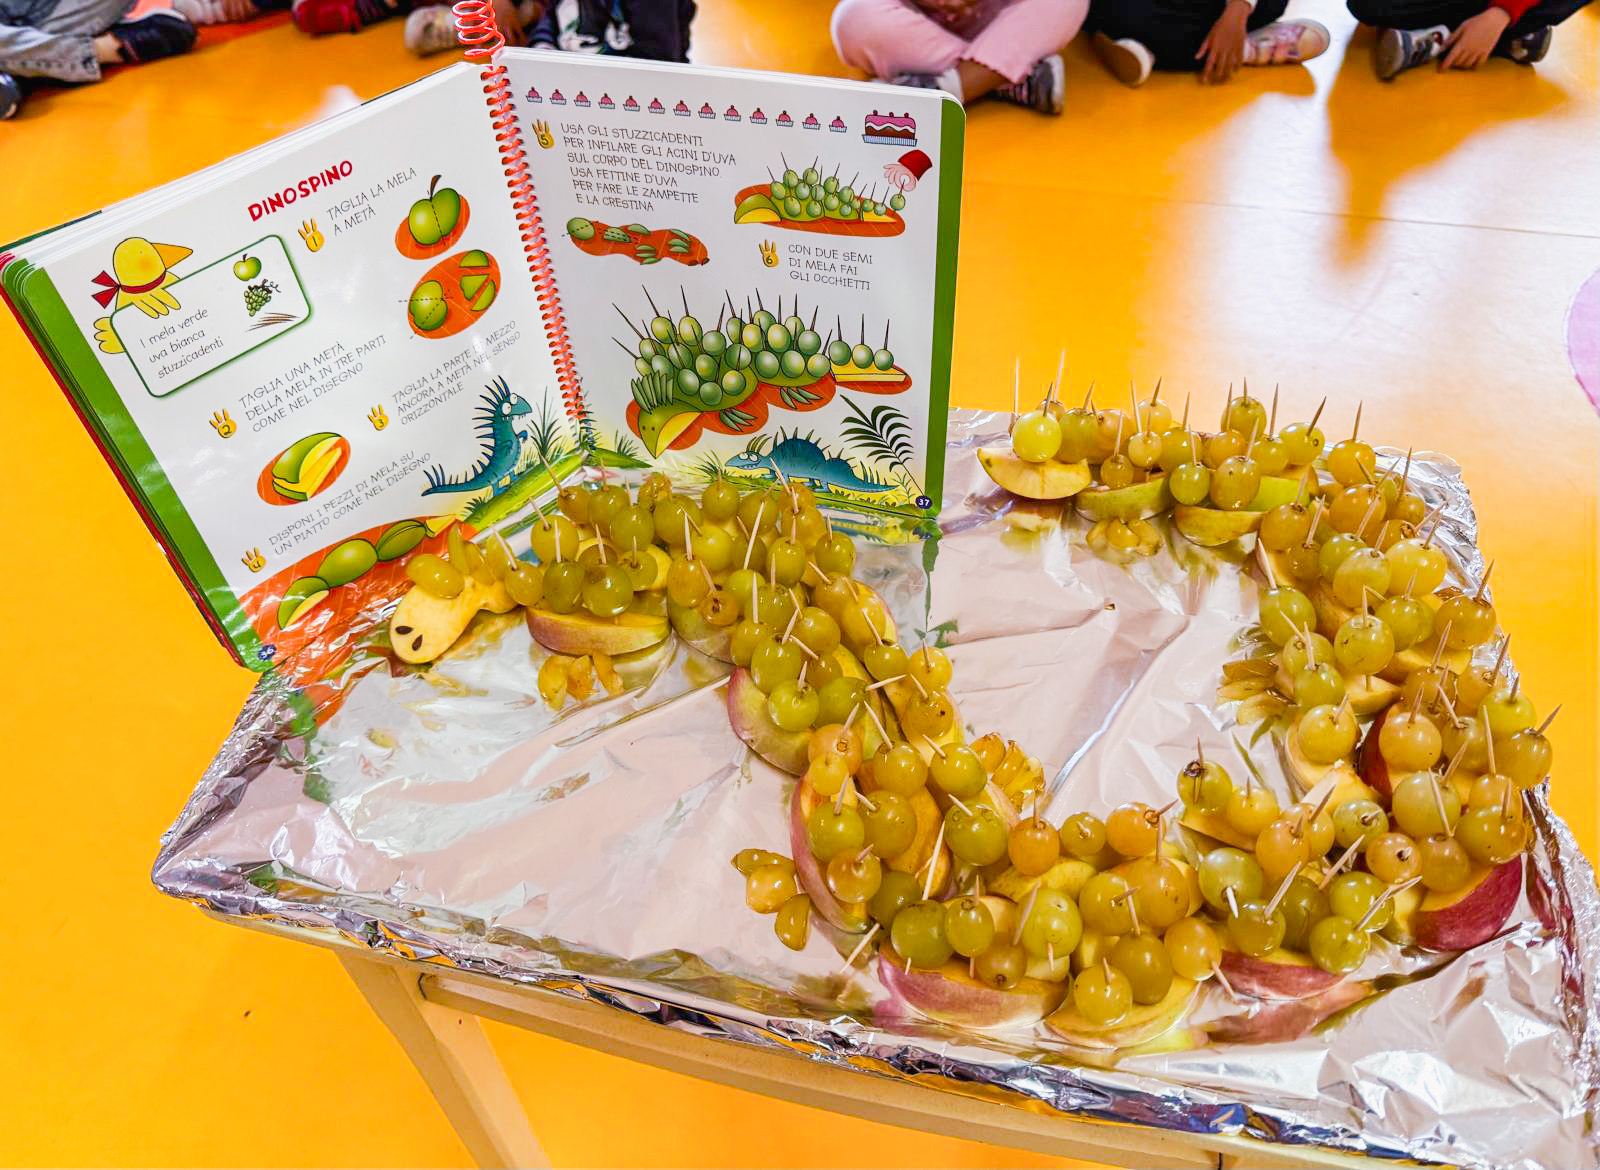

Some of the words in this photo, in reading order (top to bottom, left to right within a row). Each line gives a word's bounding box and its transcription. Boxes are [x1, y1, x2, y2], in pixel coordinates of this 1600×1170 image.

[540, 134, 549, 145] 5
[561, 123, 584, 135] USA
[588, 125, 608, 137] GLI
[612, 128, 703, 146] STUZZICADENTI
[563, 136, 584, 148] PER
[588, 139, 637, 153] INFILARE
[642, 144, 662, 156] GLI
[667, 148, 698, 161] ACINI
[702, 151, 736, 165] D'UVA
[567, 153, 589, 163] SUL
[592, 155, 627, 166] CORPO
[632, 159, 652, 170] DEL
[570, 167, 593, 178] USA
[597, 169, 640, 183] FETTINE
[645, 174, 677, 187] D'UVA
[248, 160, 353, 222] DINOSPINO
[326, 192, 369, 220] TAGLIA
[370, 184, 384, 198] LA
[387, 167, 417, 190] MELA
[573, 180, 593, 191] PER
[597, 183, 622, 194] FARE
[626, 186, 638, 196] LE
[643, 188, 699, 203] ZAMPETTE
[576, 193, 583, 203] E
[586, 194, 599, 206] LA
[602, 197, 654, 211] CRESTINA
[334, 224, 342, 236] A
[345, 204, 376, 229] METÀ
[766, 256, 773, 264] 6
[788, 244, 811, 256] CON
[815, 247, 838, 259] DUE
[843, 252, 872, 264] SEMI
[789, 257, 800, 267] DI
[805, 260, 836, 272] MELA
[841, 264, 857, 275] FAI
[790, 271, 809, 282] GLI
[814, 273, 870, 290] OCCHIETTI
[149, 326, 176, 345] mela
[178, 309, 208, 329] verde
[149, 349, 168, 363] uva
[170, 330, 205, 352] bianca
[158, 336, 224, 378] stuzzicadenti
[392, 376, 429, 404] TAGLIA
[430, 368, 442, 380] LA
[443, 350, 471, 372] PARTE
[485, 320, 516, 346] MEZZO
[238, 378, 283, 408] TAGLIA
[284, 362, 311, 382] UNA
[313, 341, 344, 366] METÀ
[245, 394, 283, 421] DELLA
[285, 374, 317, 399] MELA
[320, 365, 333, 379] IN
[334, 352, 355, 370] TRE
[356, 334, 387, 357] PARTI
[397, 386, 435, 416] ANCORA
[438, 381, 444, 391] A
[473, 354, 491, 367] NEL
[492, 331, 521, 355] SENSO
[252, 407, 288, 433] COME
[289, 394, 312, 413] NEL
[313, 362, 363, 398] DISEGNO
[401, 381, 465, 425] ORIZZONTALE
[222, 425, 232, 435] 2
[378, 419, 384, 427] 3
[268, 514, 314, 546] DISPONI
[316, 509, 322, 517] I
[324, 489, 353, 513] PEZZI
[355, 480, 368, 492] DI
[371, 461, 399, 482] MELA
[400, 450, 415, 465] SU
[275, 544, 292, 556] UN
[294, 517, 330, 544] PIATTO
[333, 497, 363, 520] COME
[365, 485, 385, 502] NEL
[387, 453, 431, 487] DISEGNO
